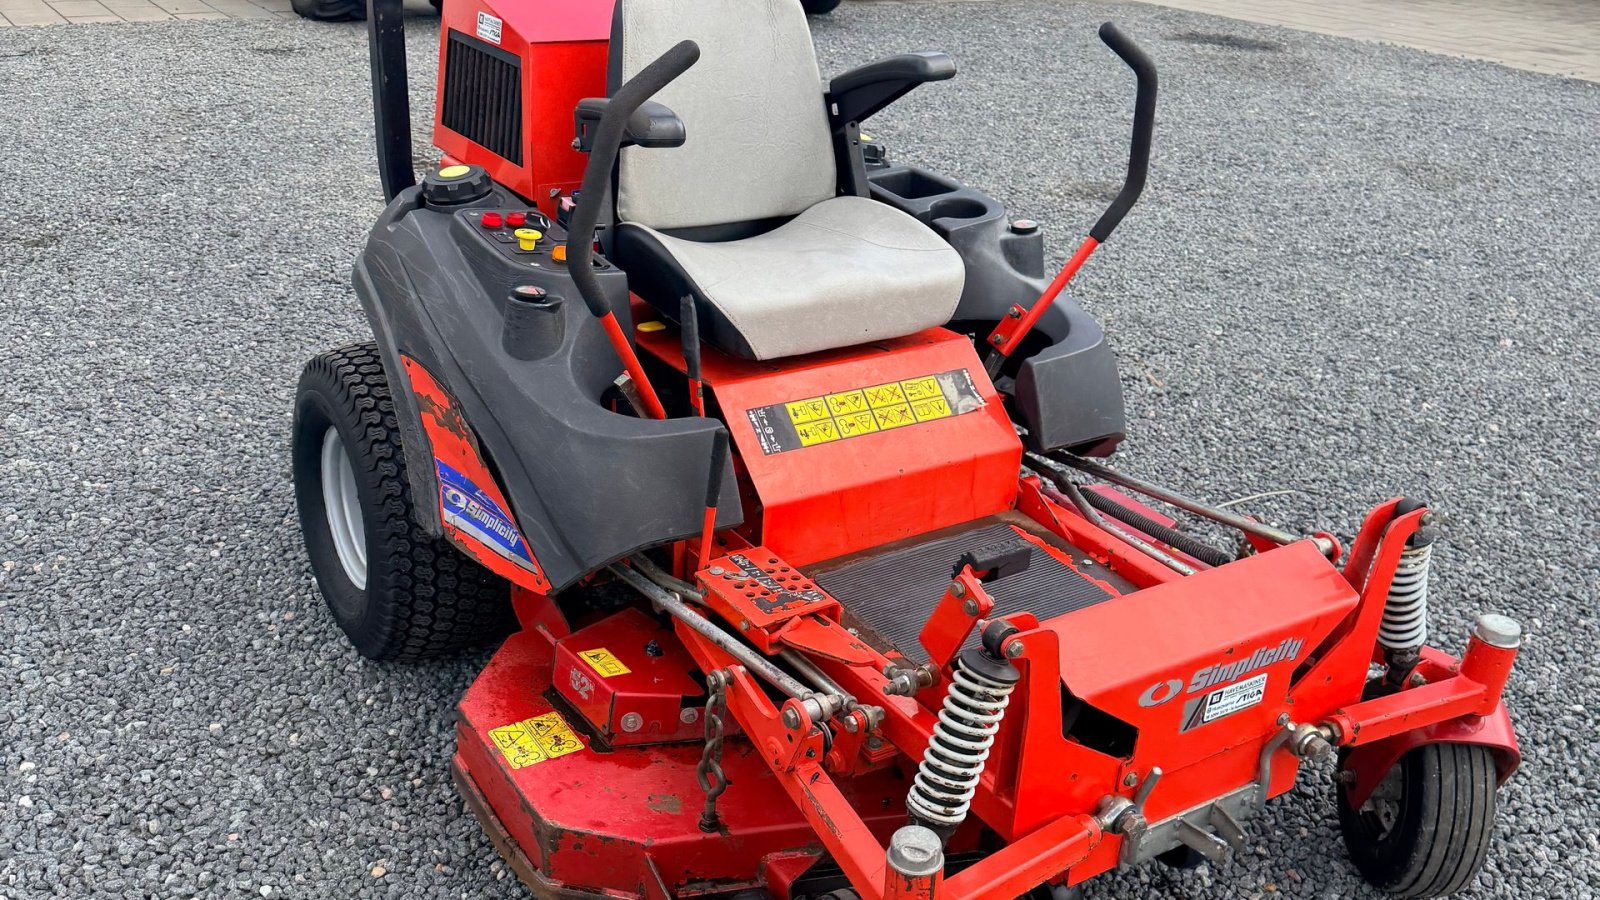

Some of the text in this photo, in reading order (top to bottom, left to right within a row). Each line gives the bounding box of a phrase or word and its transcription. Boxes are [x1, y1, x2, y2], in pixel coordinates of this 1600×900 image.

[465, 501, 519, 547] Simplicity
[1186, 637, 1304, 693] Simplicity
[1236, 689, 1262, 704] STIGA
